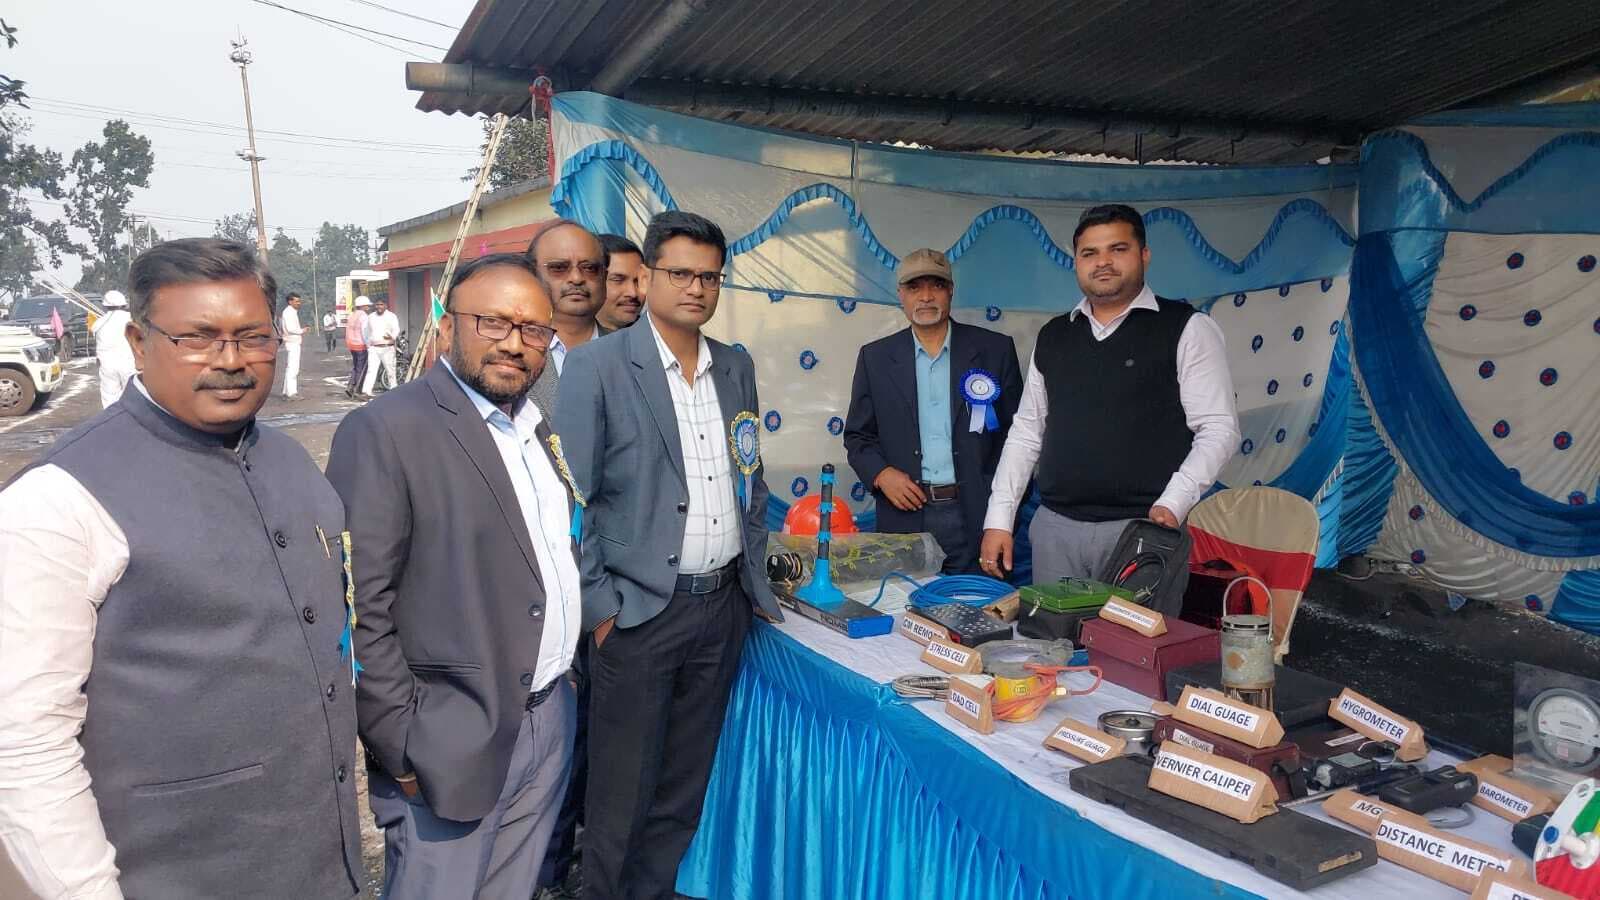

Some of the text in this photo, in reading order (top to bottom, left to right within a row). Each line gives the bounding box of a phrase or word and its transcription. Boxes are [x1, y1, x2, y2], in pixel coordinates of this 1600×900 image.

[929, 643, 966, 664] STRESS CELL
[965, 700, 977, 714] CELL
[1190, 697, 1253, 727] DIAL GUAGE
[1341, 697, 1405, 739] HYGROMETER
[1057, 729, 1108, 754] PRESSURE GUAGE
[1154, 755, 1252, 797] VERNIER CALIPER
[1479, 783, 1529, 814] BAROMETER
[1376, 823, 1446, 858] DISTANCE
